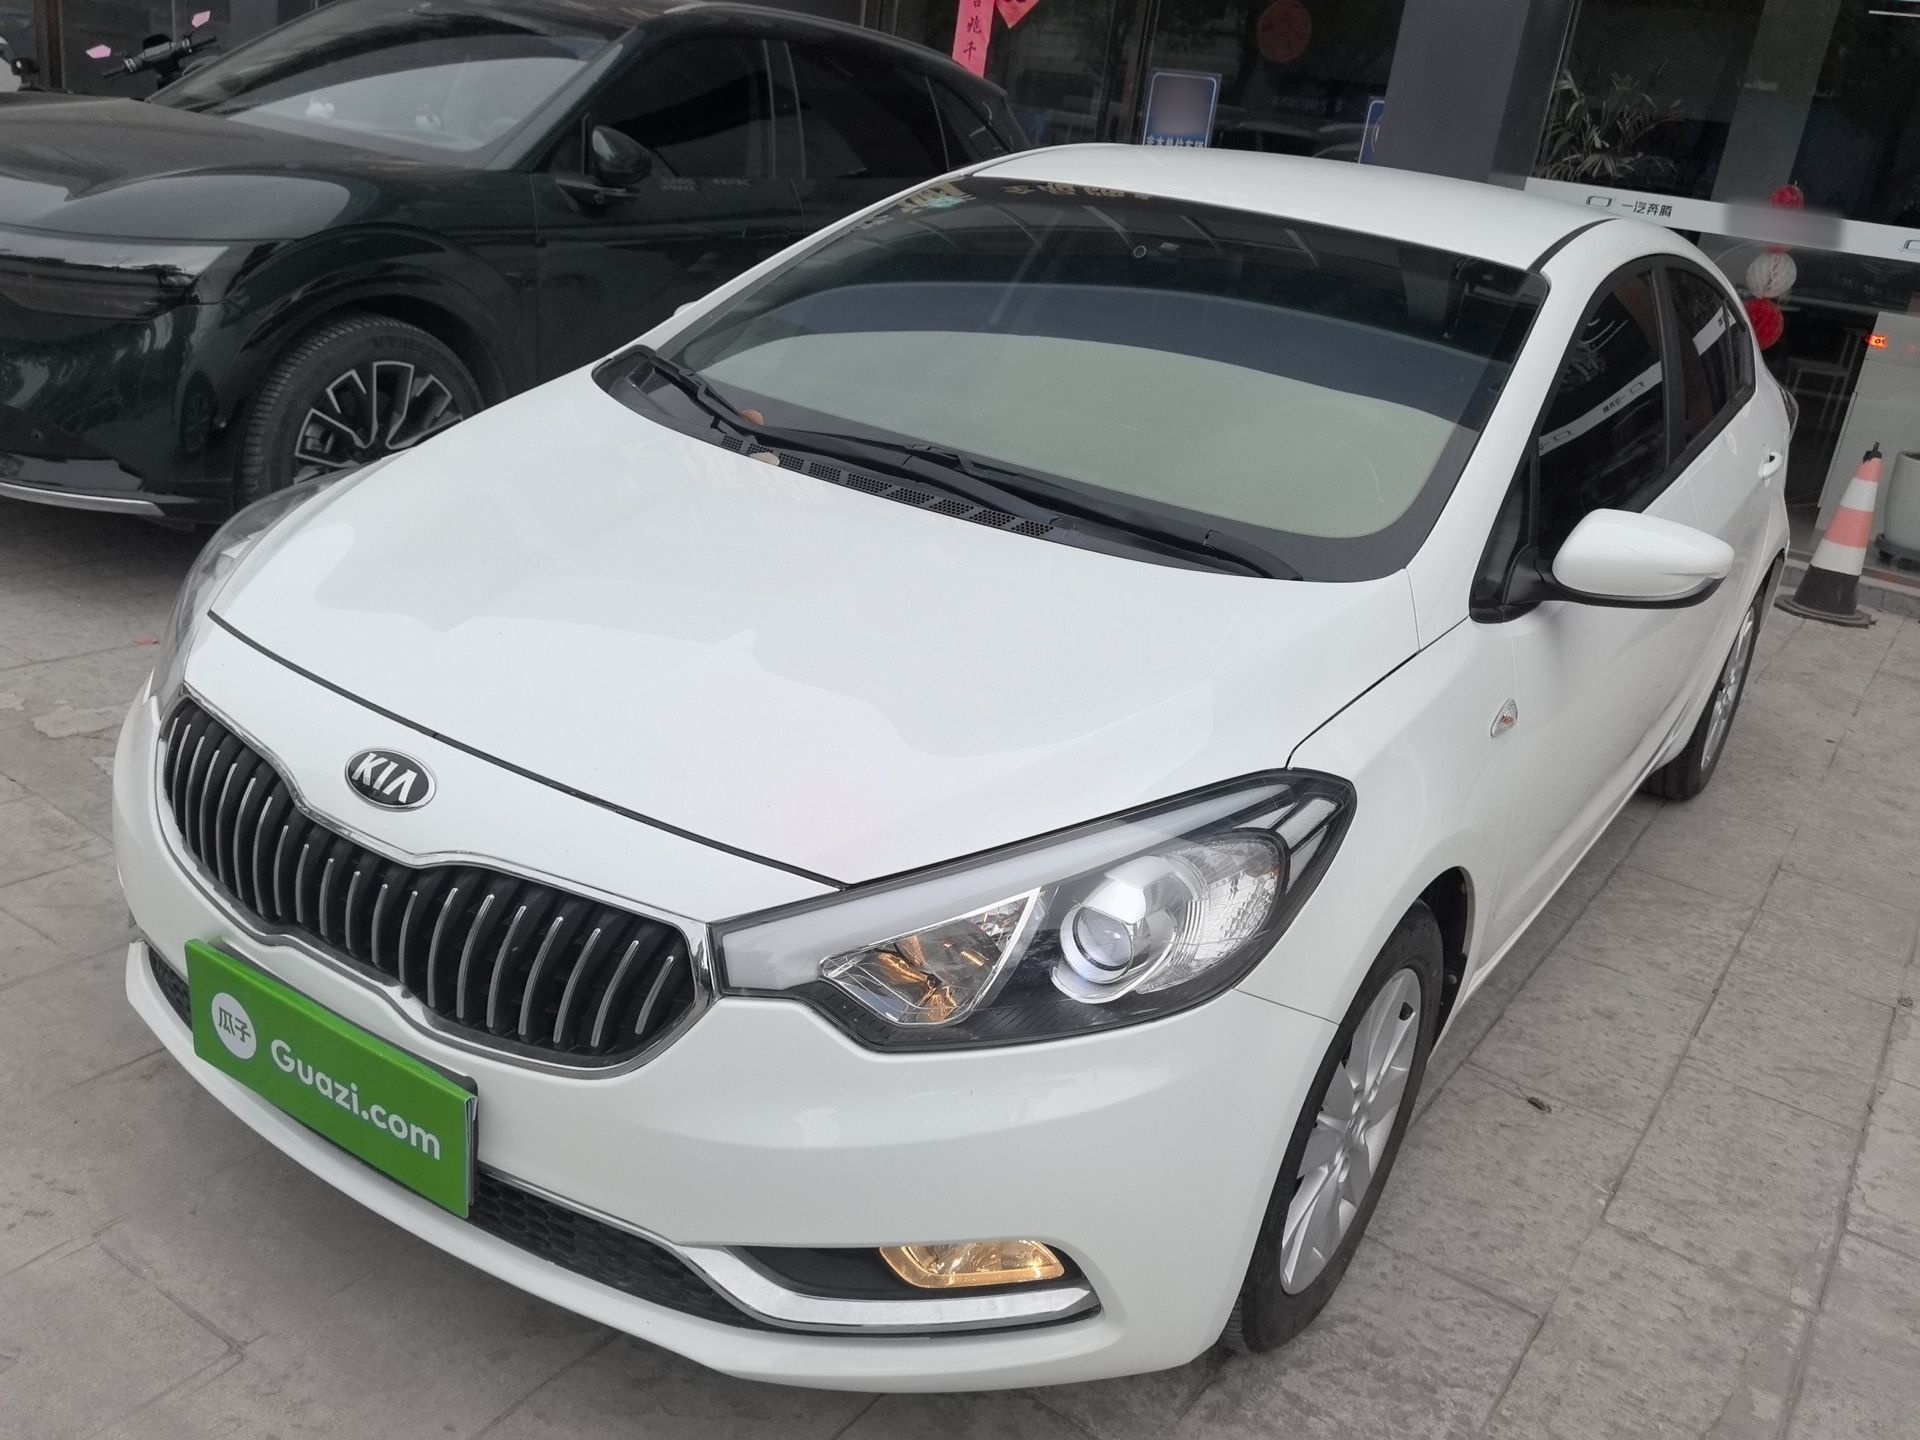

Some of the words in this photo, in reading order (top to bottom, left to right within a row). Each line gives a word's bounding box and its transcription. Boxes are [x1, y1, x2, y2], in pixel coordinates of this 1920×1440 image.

[1621, 201, 1673, 217] 一汽奔腾
[351, 752, 418, 804] KIA
[218, 1006, 251, 1043] 瓜子
[270, 1039, 441, 1161] Guazi.com
